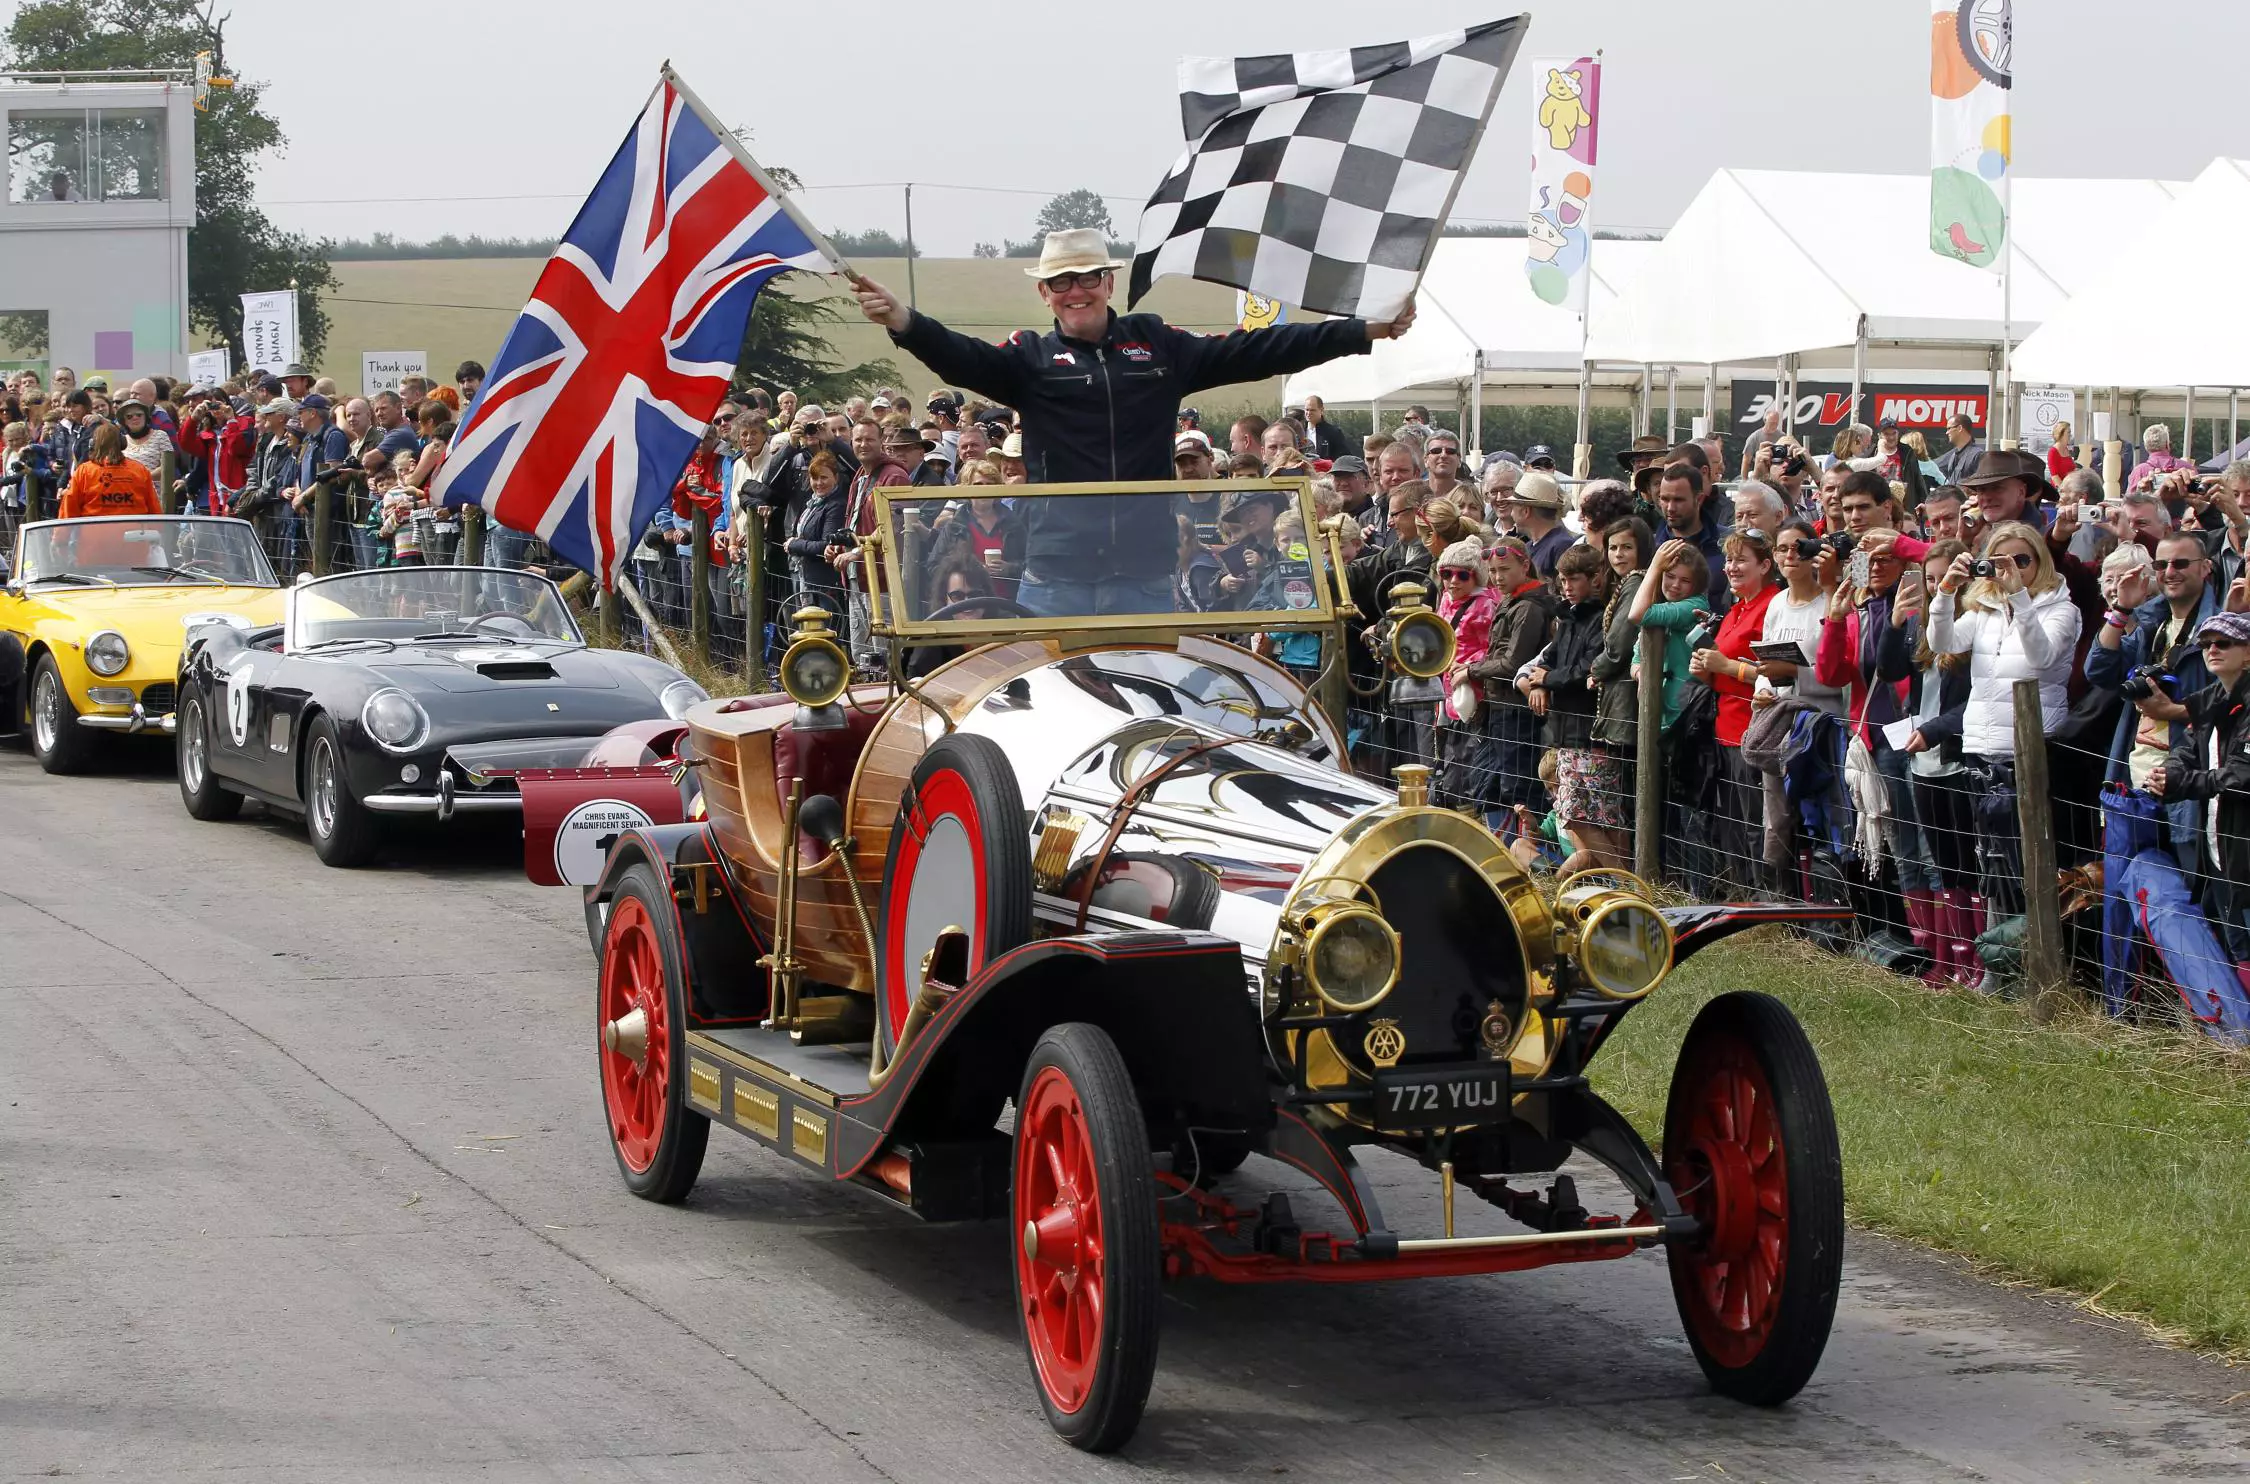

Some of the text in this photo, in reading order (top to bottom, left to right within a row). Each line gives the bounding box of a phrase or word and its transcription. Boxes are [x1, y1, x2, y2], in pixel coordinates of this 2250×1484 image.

[368, 361, 422, 374] Thank you
[372, 377, 398, 388] to all
[1880, 399, 1981, 423] MOTUL
[101, 492, 134, 504] NGK
[235, 688, 242, 737] 2
[585, 812, 630, 821] CHRIS EVANS
[572, 821, 643, 830] MAGNIFICENT SEVEN
[1388, 1081, 1497, 1112] 772 YUJ
